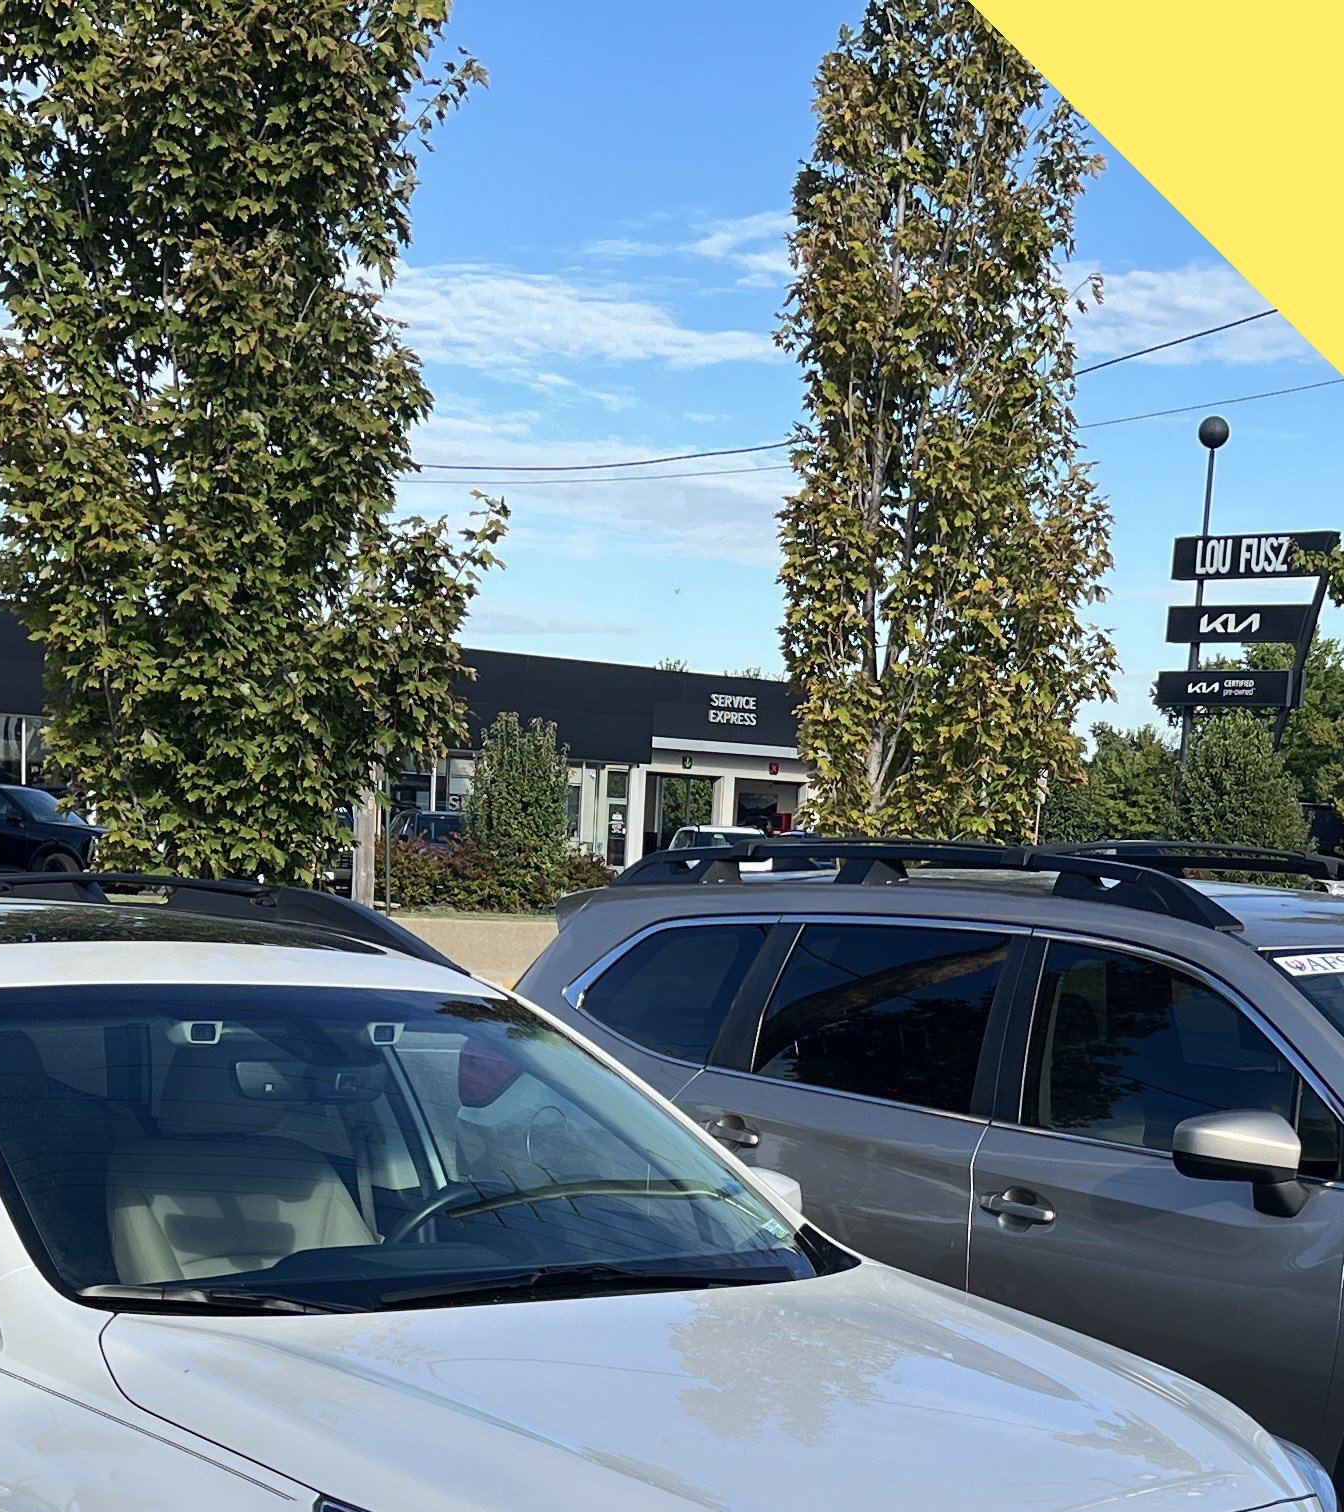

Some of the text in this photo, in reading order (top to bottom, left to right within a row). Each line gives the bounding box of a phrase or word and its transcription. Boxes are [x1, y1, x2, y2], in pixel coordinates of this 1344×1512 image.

[1195, 536, 1290, 575] LOU FUSZ
[1199, 612, 1261, 633] KIA
[1187, 679, 1255, 693] KIA CERTIFIED
[710, 693, 757, 710] SERVICE
[708, 709, 757, 726] EXPRESS
